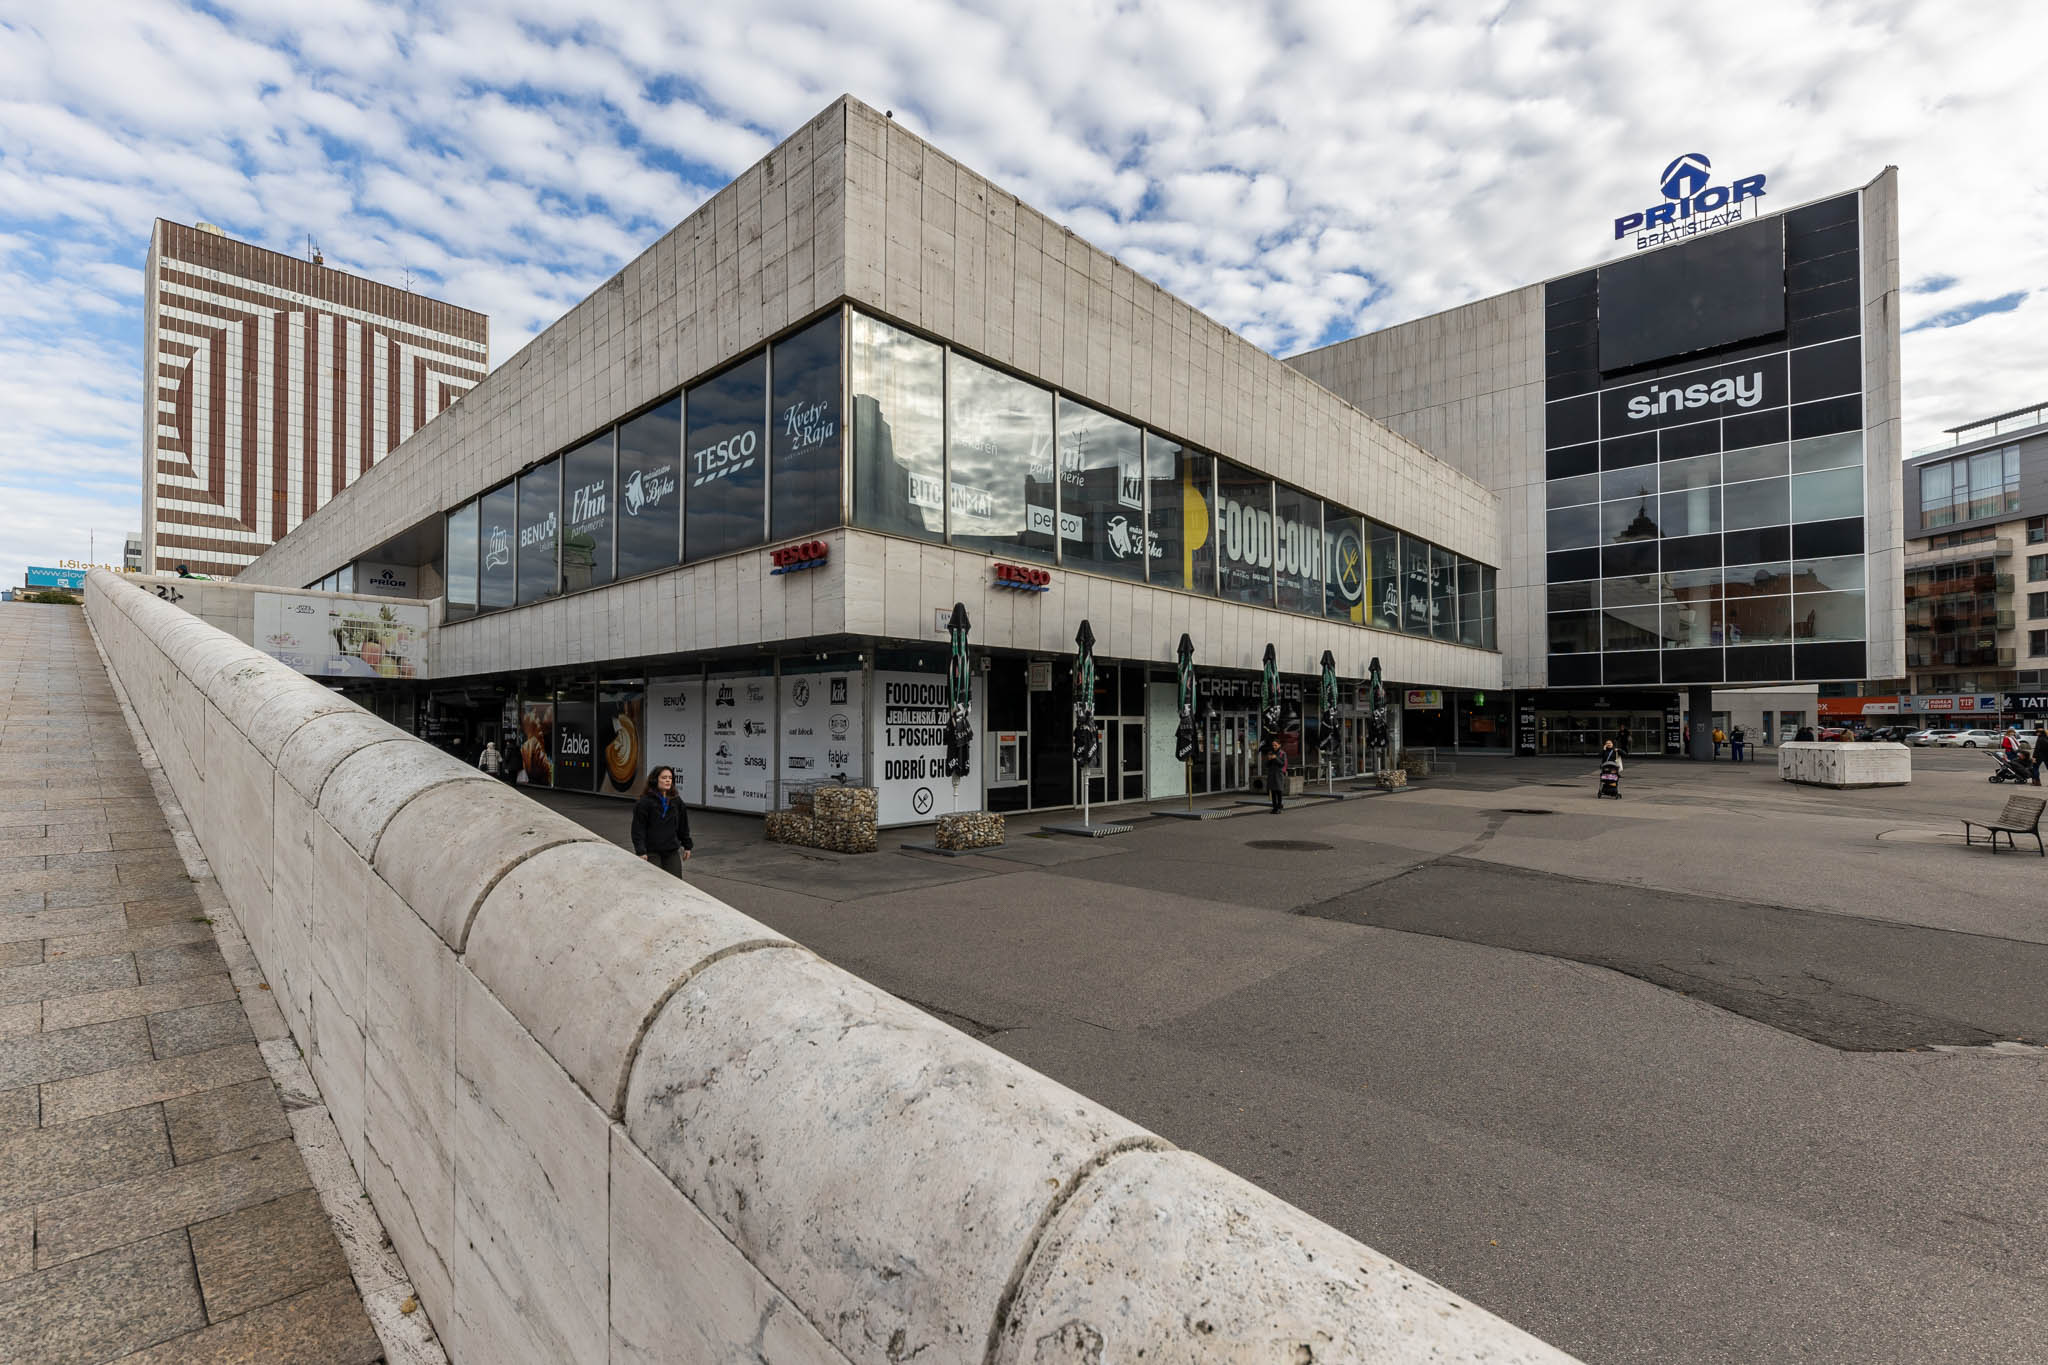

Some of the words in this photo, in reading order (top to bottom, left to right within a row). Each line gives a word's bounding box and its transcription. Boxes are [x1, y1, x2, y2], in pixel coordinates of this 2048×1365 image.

[1615, 173, 1767, 240] PRIOR
[1637, 209, 1742, 250] BRATISLAVA
[1627, 371, 1763, 419] sinsay
[783, 400, 828, 437] Kvety
[802, 420, 834, 448] Raja
[694, 430, 756, 475] TESCO
[1030, 461, 1085, 487] parfmerie
[910, 475, 992, 515] BITCINMAT
[521, 521, 546, 547] BENU
[1033, 512, 1076, 533] peco
[1133, 538, 1163, 558] Bka
[1217, 496, 1334, 584] FOODCOURT
[770, 540, 829, 567] TESCO
[370, 578, 406, 587] PRIOR
[994, 563, 1051, 585] TESCO
[886, 682, 949, 705] FOODCOU
[1199, 678, 1248, 697] CRAFT
[2019, 697, 2048, 708] TAT
[887, 708, 936, 724] JEDÁLENSKÁ
[561, 727, 590, 755] Žabka
[664, 733, 686, 743] TESCO
[886, 728, 895, 746] 1.
[899, 728, 945, 747] POSCHO
[744, 754, 767, 770] sinsay
[885, 755, 925, 780] DOBRÚ
